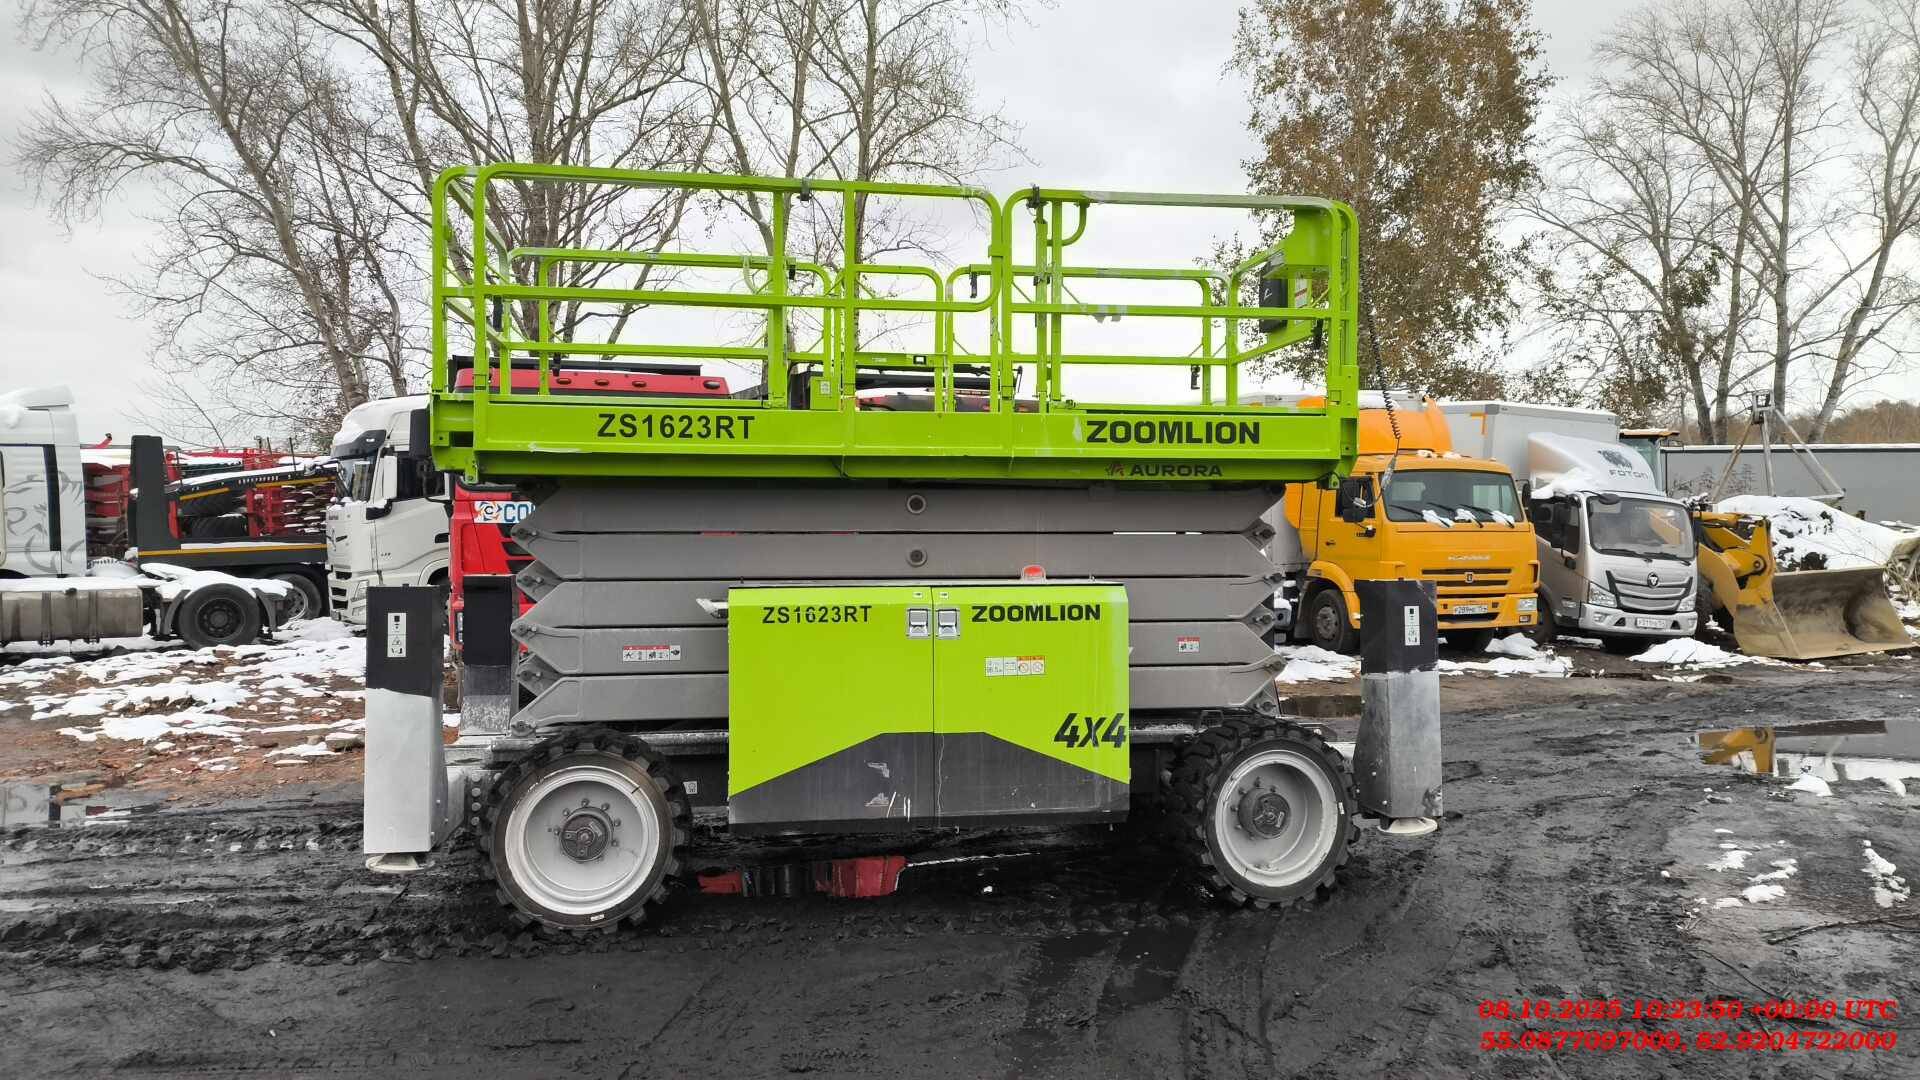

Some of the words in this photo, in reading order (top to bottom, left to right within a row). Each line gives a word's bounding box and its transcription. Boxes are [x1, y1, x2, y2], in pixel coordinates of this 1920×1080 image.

[597, 413, 755, 439] ZS1623RT
[1086, 420, 1260, 444] ZOOMLION
[1130, 463, 1222, 477] AURORA
[762, 605, 872, 623] ZS1623RT
[971, 604, 1100, 622] ZOOMLION
